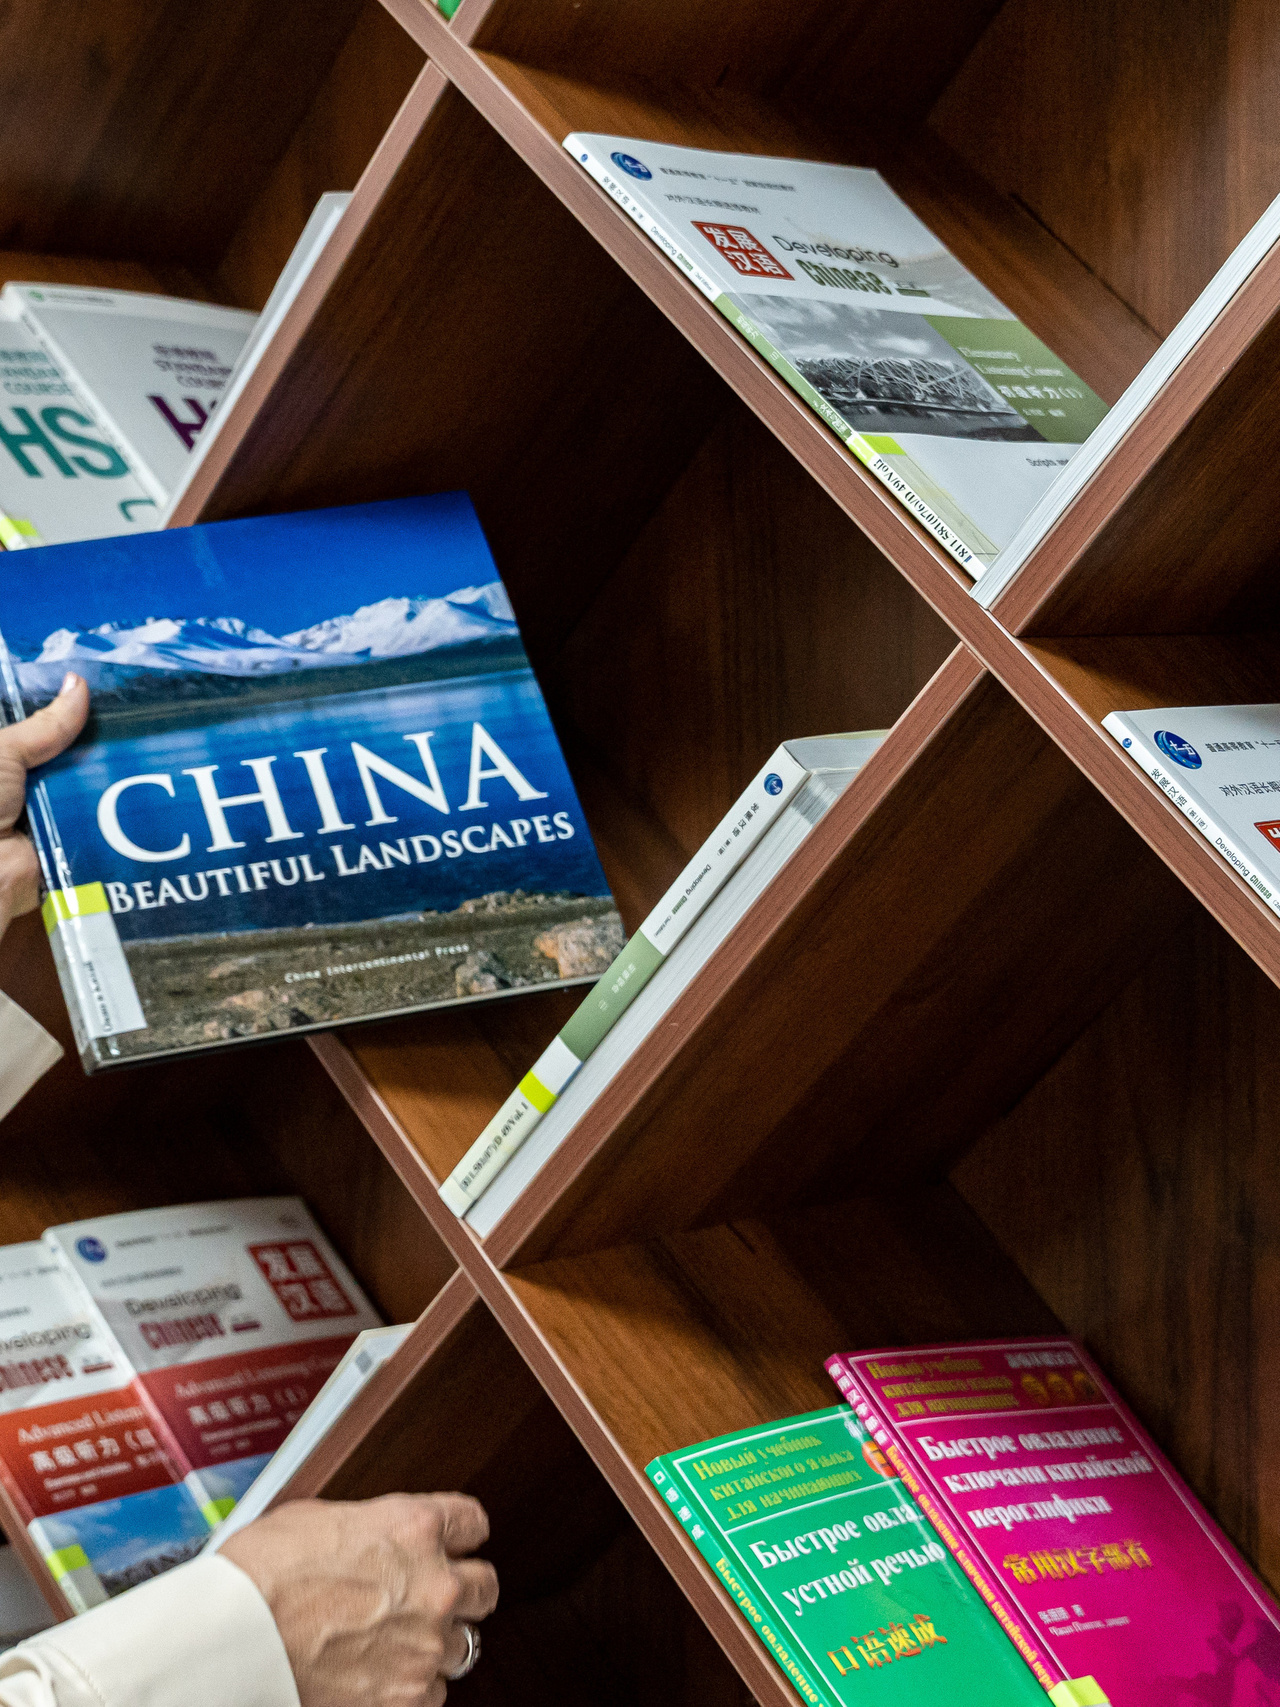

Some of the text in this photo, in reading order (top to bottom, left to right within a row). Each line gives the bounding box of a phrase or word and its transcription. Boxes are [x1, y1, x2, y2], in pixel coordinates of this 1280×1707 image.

[650, 226, 677, 256] Developing
[703, 226, 762, 252] 发展
[771, 235, 899, 268] Developing
[725, 250, 785, 276] 汉语
[795, 258, 892, 295] Chinese
[1025, 457, 1057, 468] Scripts
[97, 722, 549, 863] CHINA
[1151, 768, 1187, 807] 发展汉语
[106, 811, 575, 914] BEAUTIFUL LANDSCAPES
[685, 863, 712, 896] Developing
[1215, 837, 1251, 877] Developing
[1250, 874, 1273, 899] Chinese
[284, 944, 470, 984] China Intercontinental Press
[125, 1282, 243, 1316] Developing
[18, 1413, 95, 1446] Advanced
[916, 1426, 1124, 1461] Быстрое овладение
[692, 1447, 758, 1481] Новый
[709, 1462, 807, 1501] китайского
[942, 1450, 1154, 1494] ключами китайской
[727, 1470, 863, 1522] для начинающих
[967, 1493, 1113, 1531] иероглифики
[748, 1520, 862, 1570] Быстрое
[885, 1445, 920, 1493] Быстрое
[918, 1493, 959, 1550] овладение
[991, 1601, 1039, 1662] китайской
[781, 1541, 947, 1617] устной речью
[715, 1557, 820, 1704] Быстрое овладение
[827, 1613, 948, 1677] 口语速成
